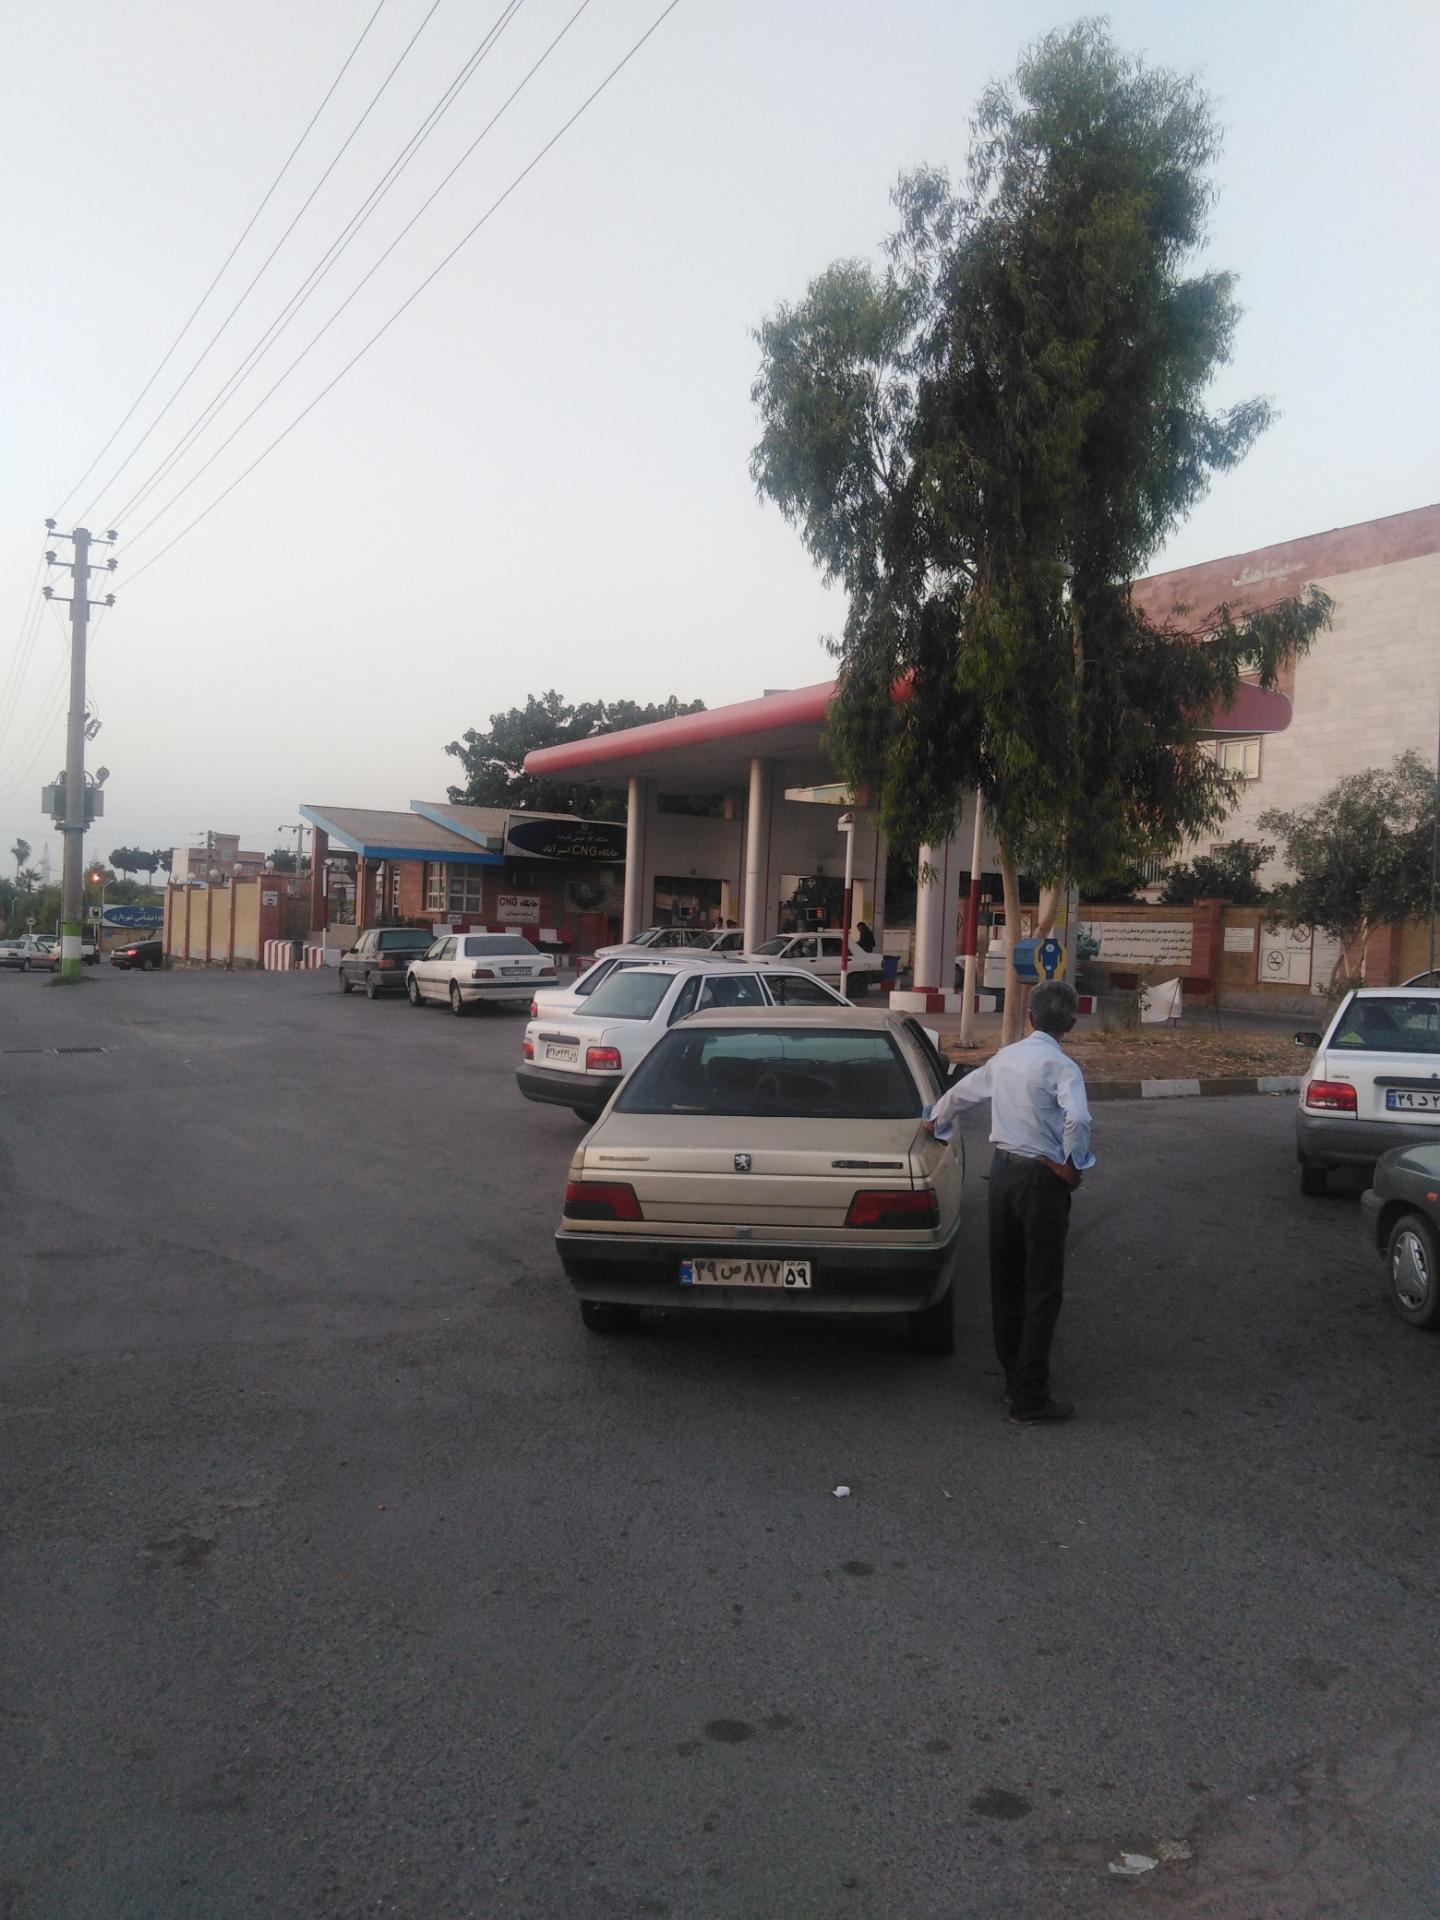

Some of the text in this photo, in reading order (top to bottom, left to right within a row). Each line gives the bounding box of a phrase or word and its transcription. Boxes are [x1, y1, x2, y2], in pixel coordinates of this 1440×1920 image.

[572, 844, 598, 857] CNG
[499, 896, 538, 908] جایگاه CNG
[785, 1268, 808, 1286] ۵۹
